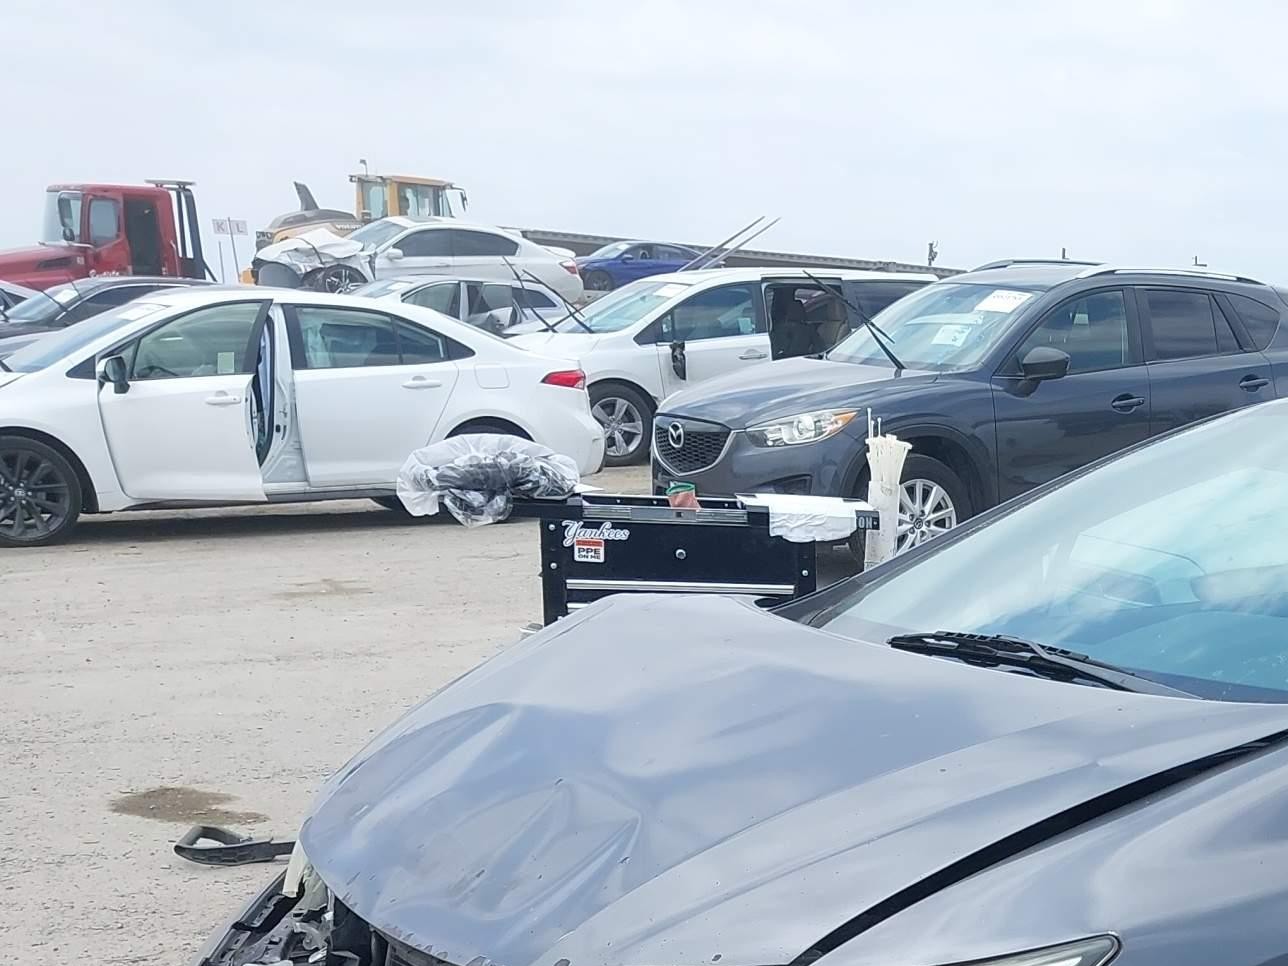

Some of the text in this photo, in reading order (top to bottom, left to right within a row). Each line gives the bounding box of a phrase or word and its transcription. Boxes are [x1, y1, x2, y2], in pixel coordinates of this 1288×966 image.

[216, 220, 226, 232] K
[236, 221, 244, 233] L
[562, 520, 630, 547] Yankees
[577, 547, 601, 555] PPE
